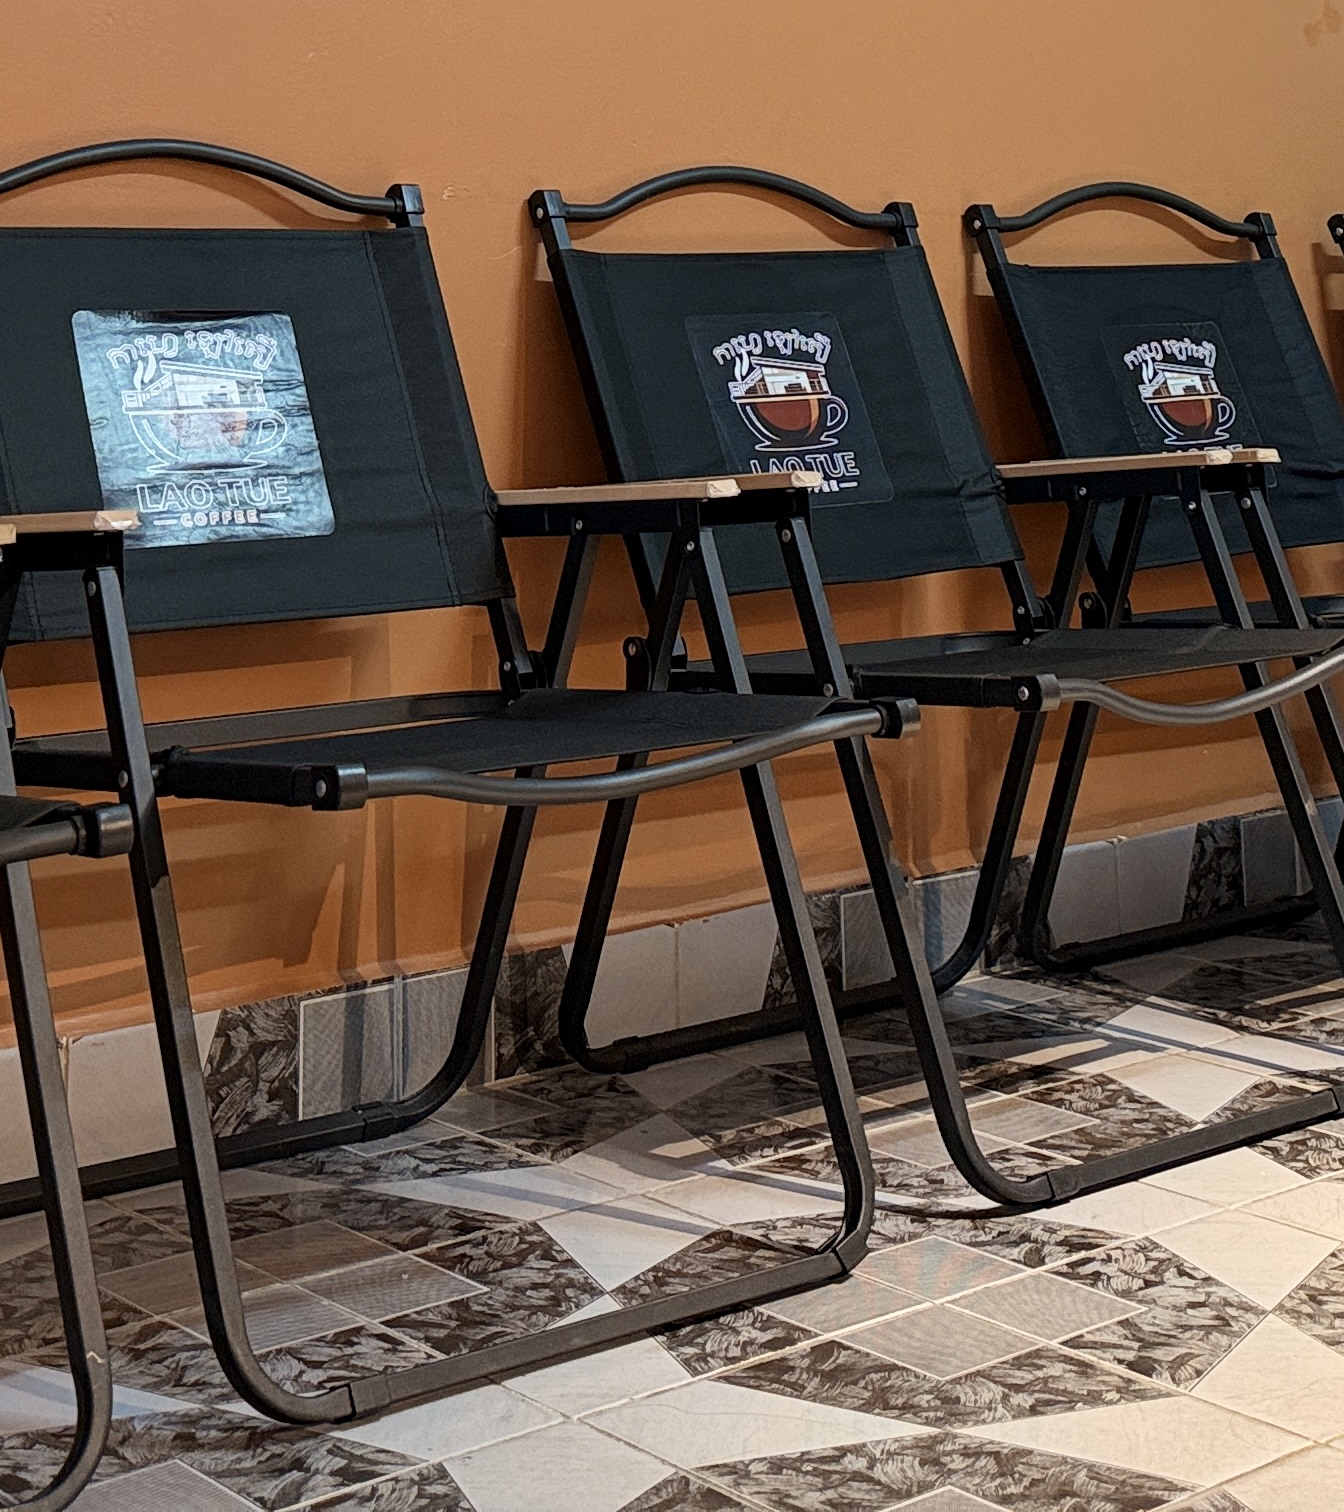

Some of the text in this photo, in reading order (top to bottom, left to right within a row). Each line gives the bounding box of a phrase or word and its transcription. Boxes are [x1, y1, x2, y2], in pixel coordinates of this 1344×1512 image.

[805, 451, 860, 477] TUE
[136, 476, 291, 513] LAO TUE
[180, 510, 261, 527] COFFEE
